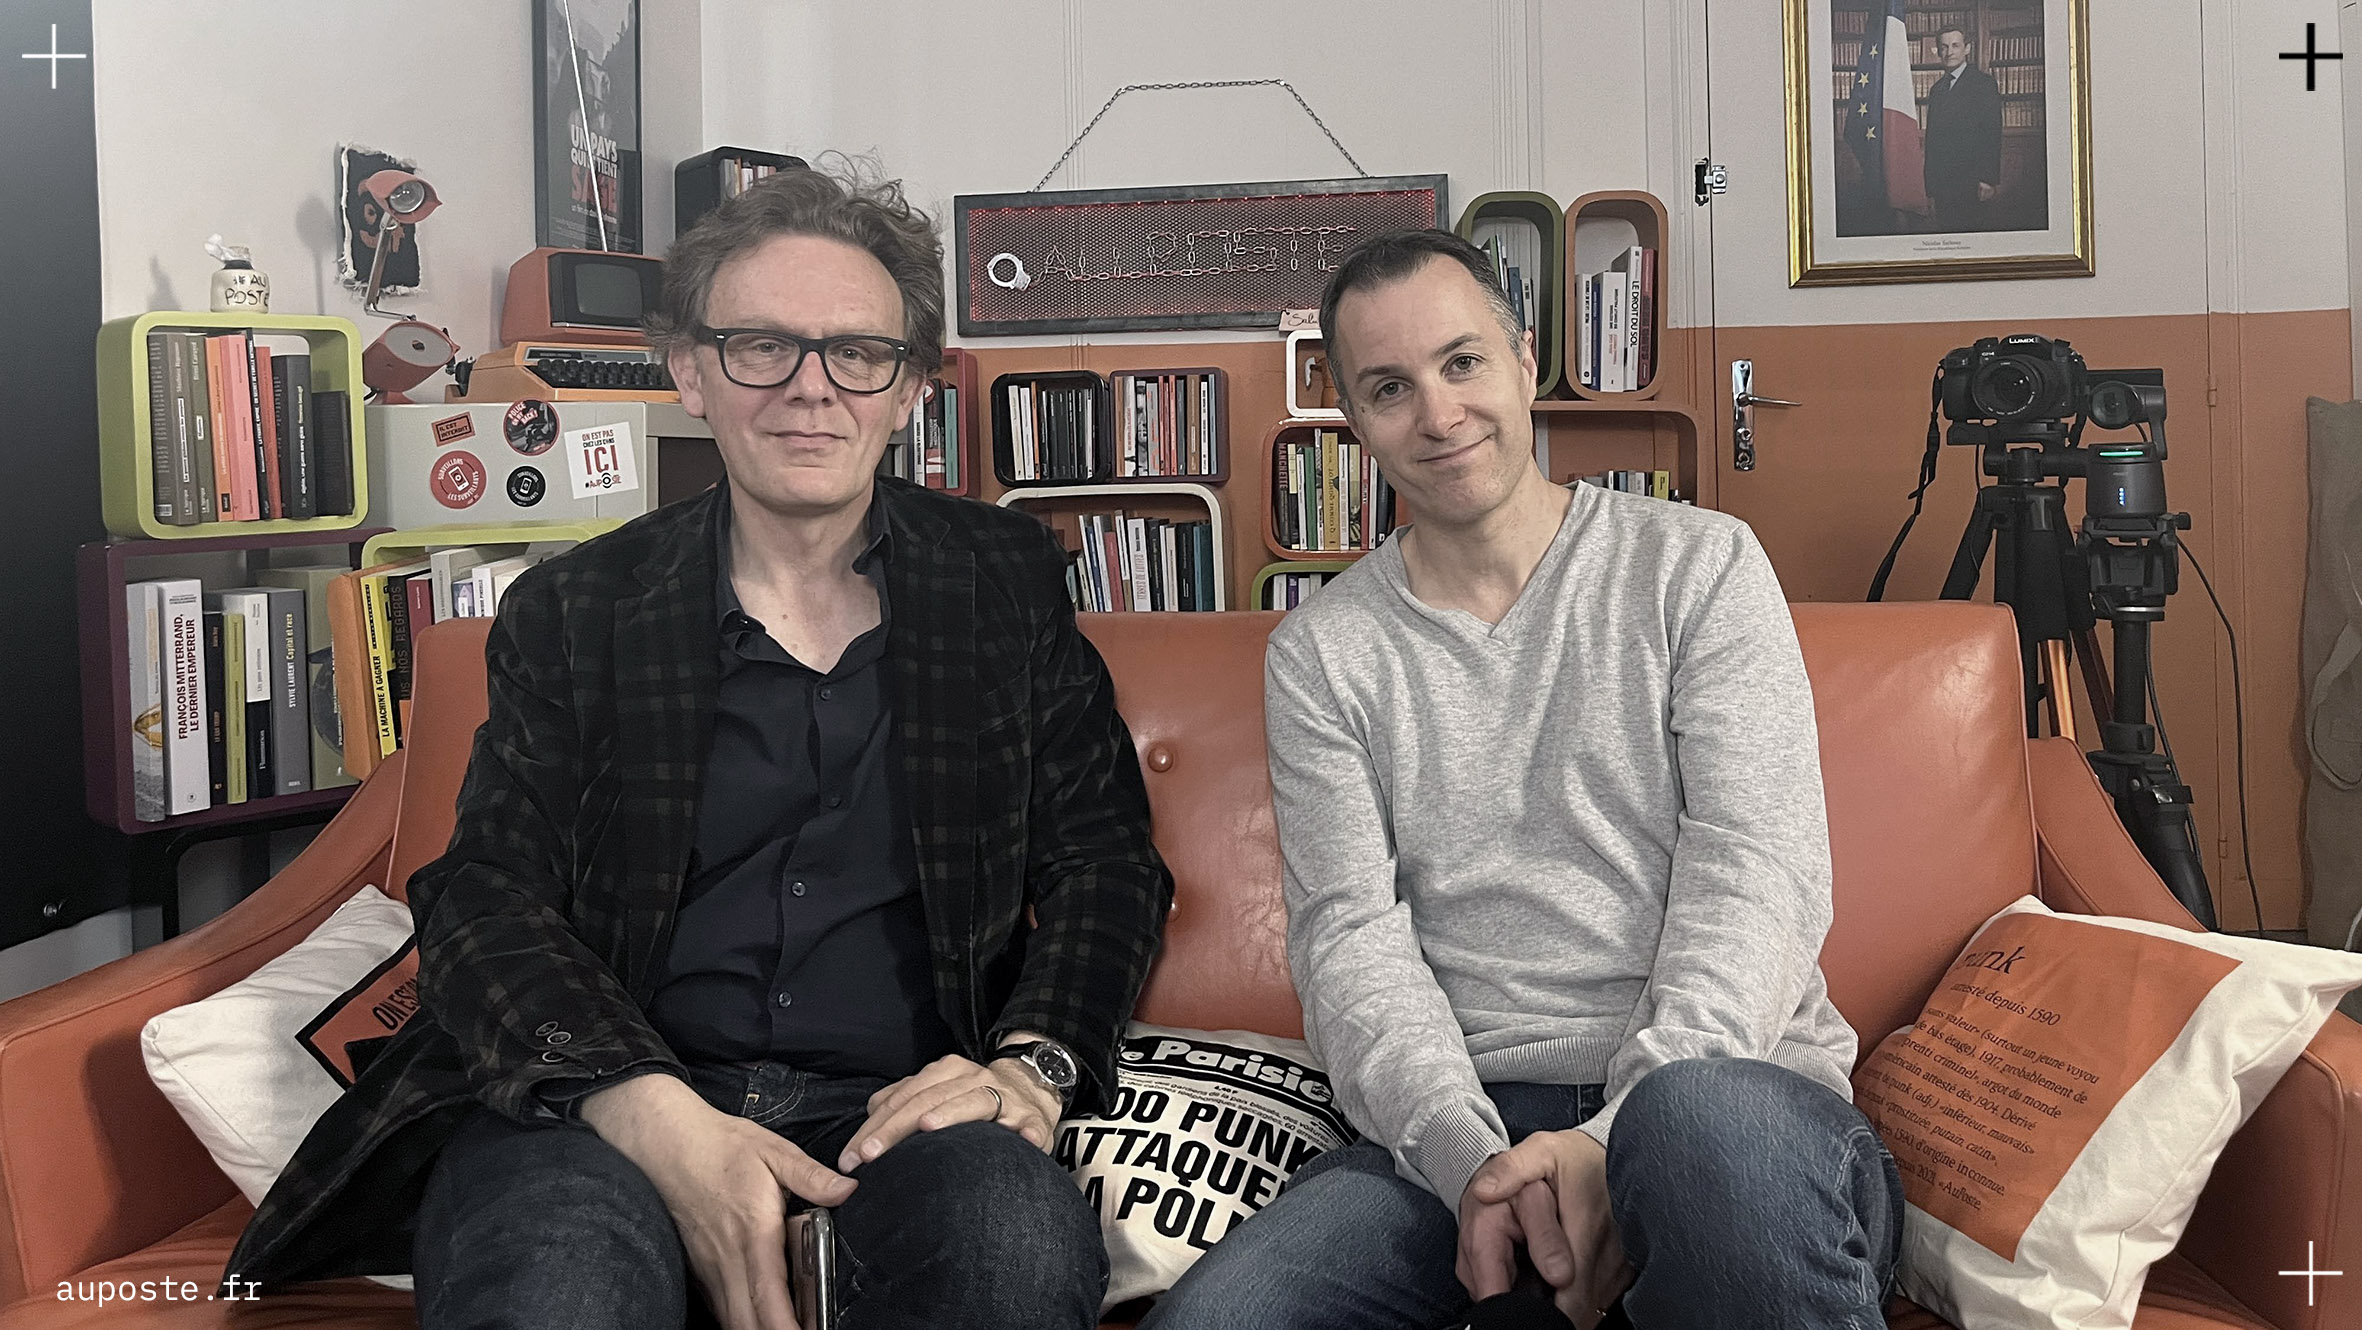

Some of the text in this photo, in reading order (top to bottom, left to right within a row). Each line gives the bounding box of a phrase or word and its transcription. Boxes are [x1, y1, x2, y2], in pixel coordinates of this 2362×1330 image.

[590, 132, 617, 163] PAYS
[225, 288, 269, 307] POSTE
[1630, 280, 1639, 348] LE DROIT DU SOL
[591, 431, 602, 440] EST
[602, 429, 614, 438] PAS
[584, 444, 619, 475] ICI
[1278, 443, 1288, 489] MANCHETTE
[285, 613, 293, 628] race
[391, 586, 406, 641] REGARDS
[173, 613, 187, 685] MITTERRAND,
[285, 637, 295, 660] Capital
[397, 650, 409, 674] NOS
[185, 619, 199, 731] LE DERNIER EMPEREUR
[286, 661, 296, 708] SYLVIE LAURENT
[373, 655, 383, 685] GAGNER
[176, 686, 190, 739] FRANÇOIS
[377, 693, 389, 726] MACHINE
[382, 728, 390, 737] LA
[258, 730, 266, 770] Flammarion
[372, 1001, 409, 1030] ON
[1985, 990, 2028, 1015] depuis
[2027, 1007, 2061, 1026] 1590
[1120, 1046, 1144, 1061] e
[1927, 1025, 1943, 1040] bas
[2002, 1061, 2072, 1098] probablement
[2073, 1091, 2089, 1105] de
[1980, 1028, 2023, 1055] (surtout
[2022, 1047, 2036, 1058] un
[2033, 1050, 2065, 1070] jeune
[2066, 1063, 2100, 1085] voyou
[1922, 1068, 1957, 1093] attesté
[1956, 1087, 1975, 1103] dès
[1999, 1107, 2036, 1131] Dérivé
[1981, 1076, 2011, 1095] argot
[2009, 1086, 2022, 1101] du
[2021, 1093, 2062, 1118] monde
[1283, 1115, 1298, 1125] des
[1299, 1122, 1329, 1143] voitures
[1284, 1122, 1296, 1131] 60
[1887, 1077, 1913, 1095] punk
[1911, 1087, 1941, 1109] (adj.)
[1987, 1128, 2035, 1155] mauvais»
[1915, 1139, 1956, 1169] d'origine
